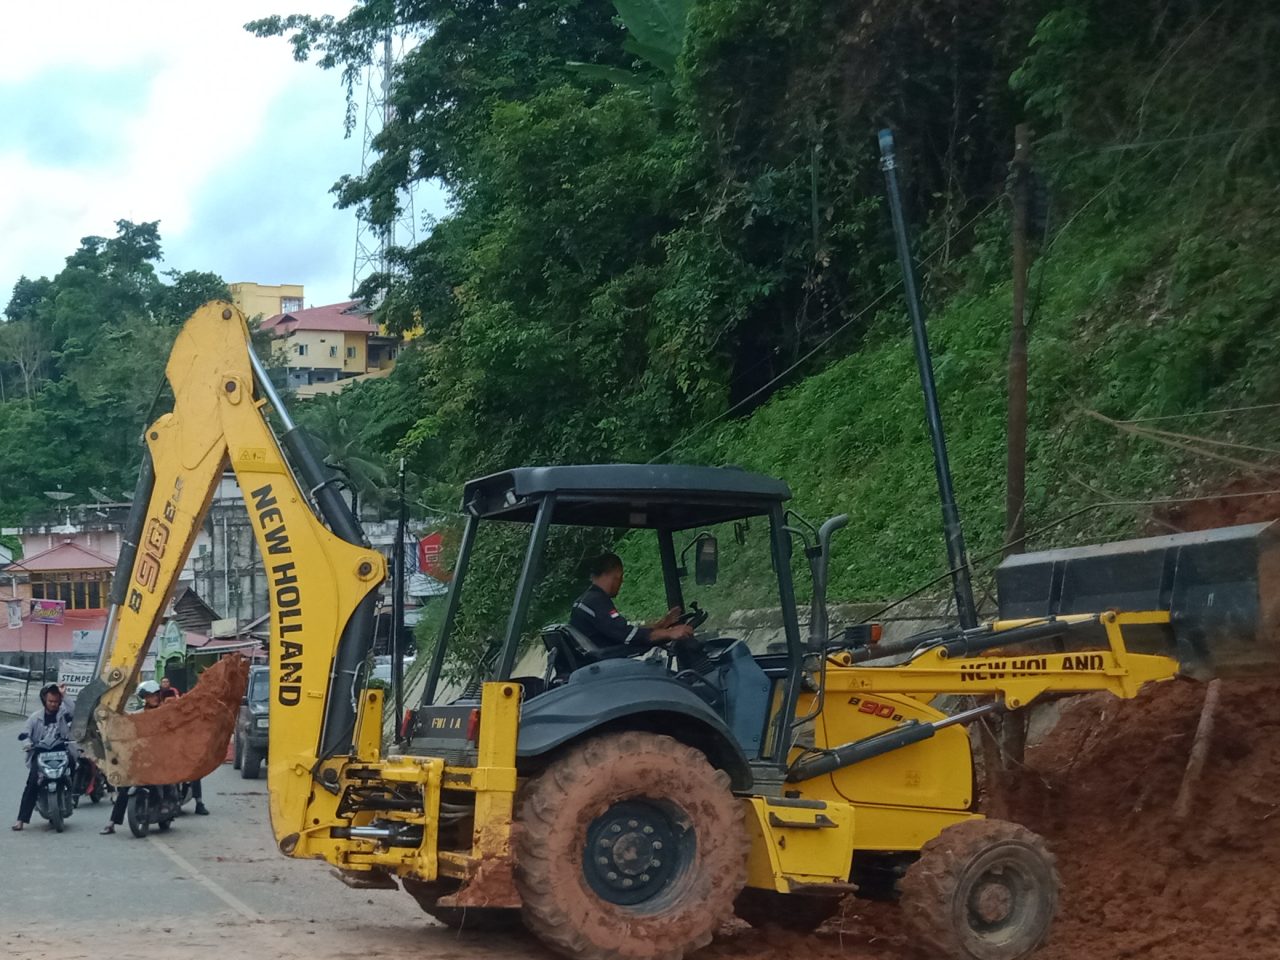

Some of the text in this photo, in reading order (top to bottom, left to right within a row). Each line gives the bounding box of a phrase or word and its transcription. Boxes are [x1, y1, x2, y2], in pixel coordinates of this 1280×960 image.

[251, 483, 304, 707] NEW HOLLAND
[961, 661, 1007, 683] NEW
